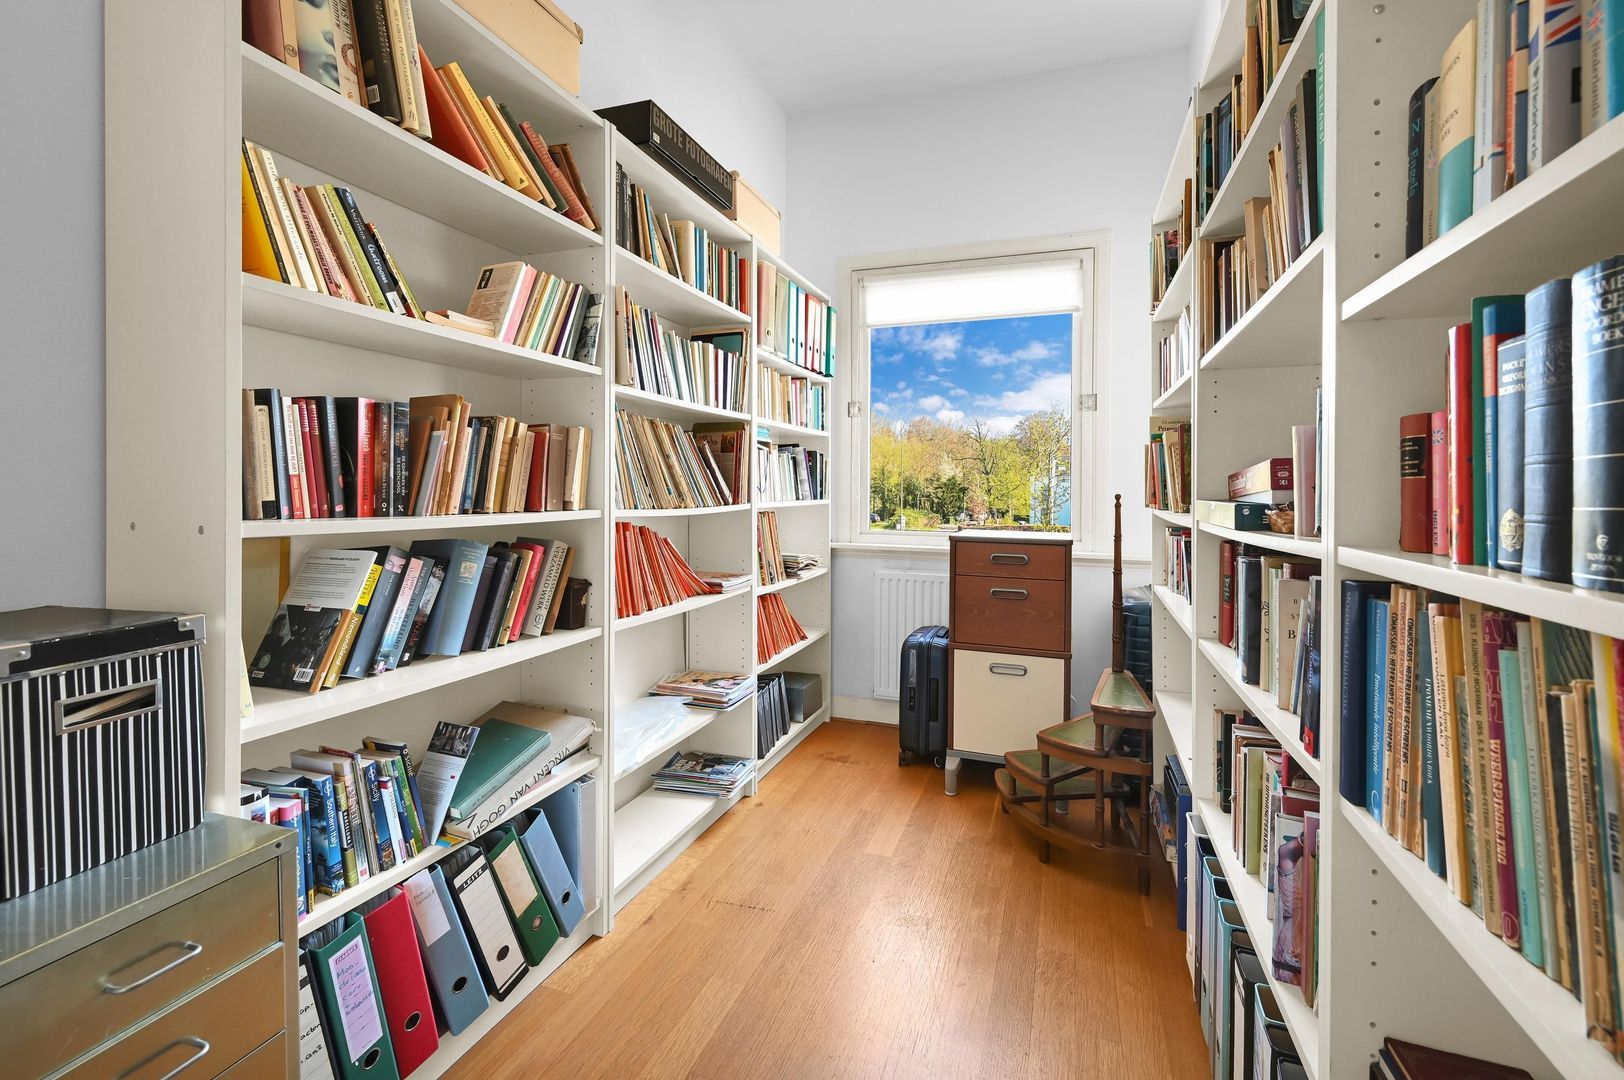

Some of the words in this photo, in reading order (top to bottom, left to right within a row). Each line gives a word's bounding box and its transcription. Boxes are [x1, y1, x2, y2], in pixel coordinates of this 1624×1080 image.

[1590, 40, 1600, 118] Nederlands
[653, 107, 683, 149] GROTE
[686, 137, 733, 193] FOTOGRAFEN
[1409, 148, 1418, 196] Engels
[365, 242, 391, 284] Chatroom
[543, 545, 561, 588] VERZAMELD
[553, 547, 567, 575] WILLEM
[359, 566, 377, 600] WALTERS
[406, 597, 415, 611] HET
[536, 588, 548, 611] WERK
[542, 574, 558, 610] ELSSCHOT
[334, 616, 359, 666] Niemandsland
[393, 612, 410, 650] WEESKIND
[1389, 612, 1397, 654] COMMISSARIS
[1405, 618, 1413, 663] COMMISSARIS
[1342, 591, 1351, 717] MOEDERTAALDIDACTIEK
[1468, 613, 1477, 629] DRS.
[1475, 720, 1484, 737] DRS.
[1373, 673, 1381, 721] Emotionele
[1387, 658, 1395, 703] NEDERLANDSE
[1403, 668, 1412, 718] NEDERLANDSE
[1371, 723, 1379, 773] intelligentie
[1402, 722, 1410, 768] GESCHIEDENIS
[1422, 678, 1435, 783] EPONIEMENWOORDENBOEK
[1442, 735, 1450, 758] lezen
[533, 746, 571, 784] VINCENT
[1265, 772, 1271, 782] DE
[369, 782, 380, 801] Sicily
[510, 783, 531, 806] VAN
[1489, 738, 1507, 864] WEERSPIEGELING
[1527, 747, 1542, 837] LETTERKUNDIG
[326, 797, 336, 831] Southern
[342, 811, 351, 843] BARCELONA
[473, 804, 506, 838] GOGH
[1607, 811, 1618, 828] Bij
[328, 832, 337, 847] Italy
[1609, 832, 1619, 847] de
[463, 868, 484, 888] LEITZ
[1534, 841, 1546, 897] KONTAKT
